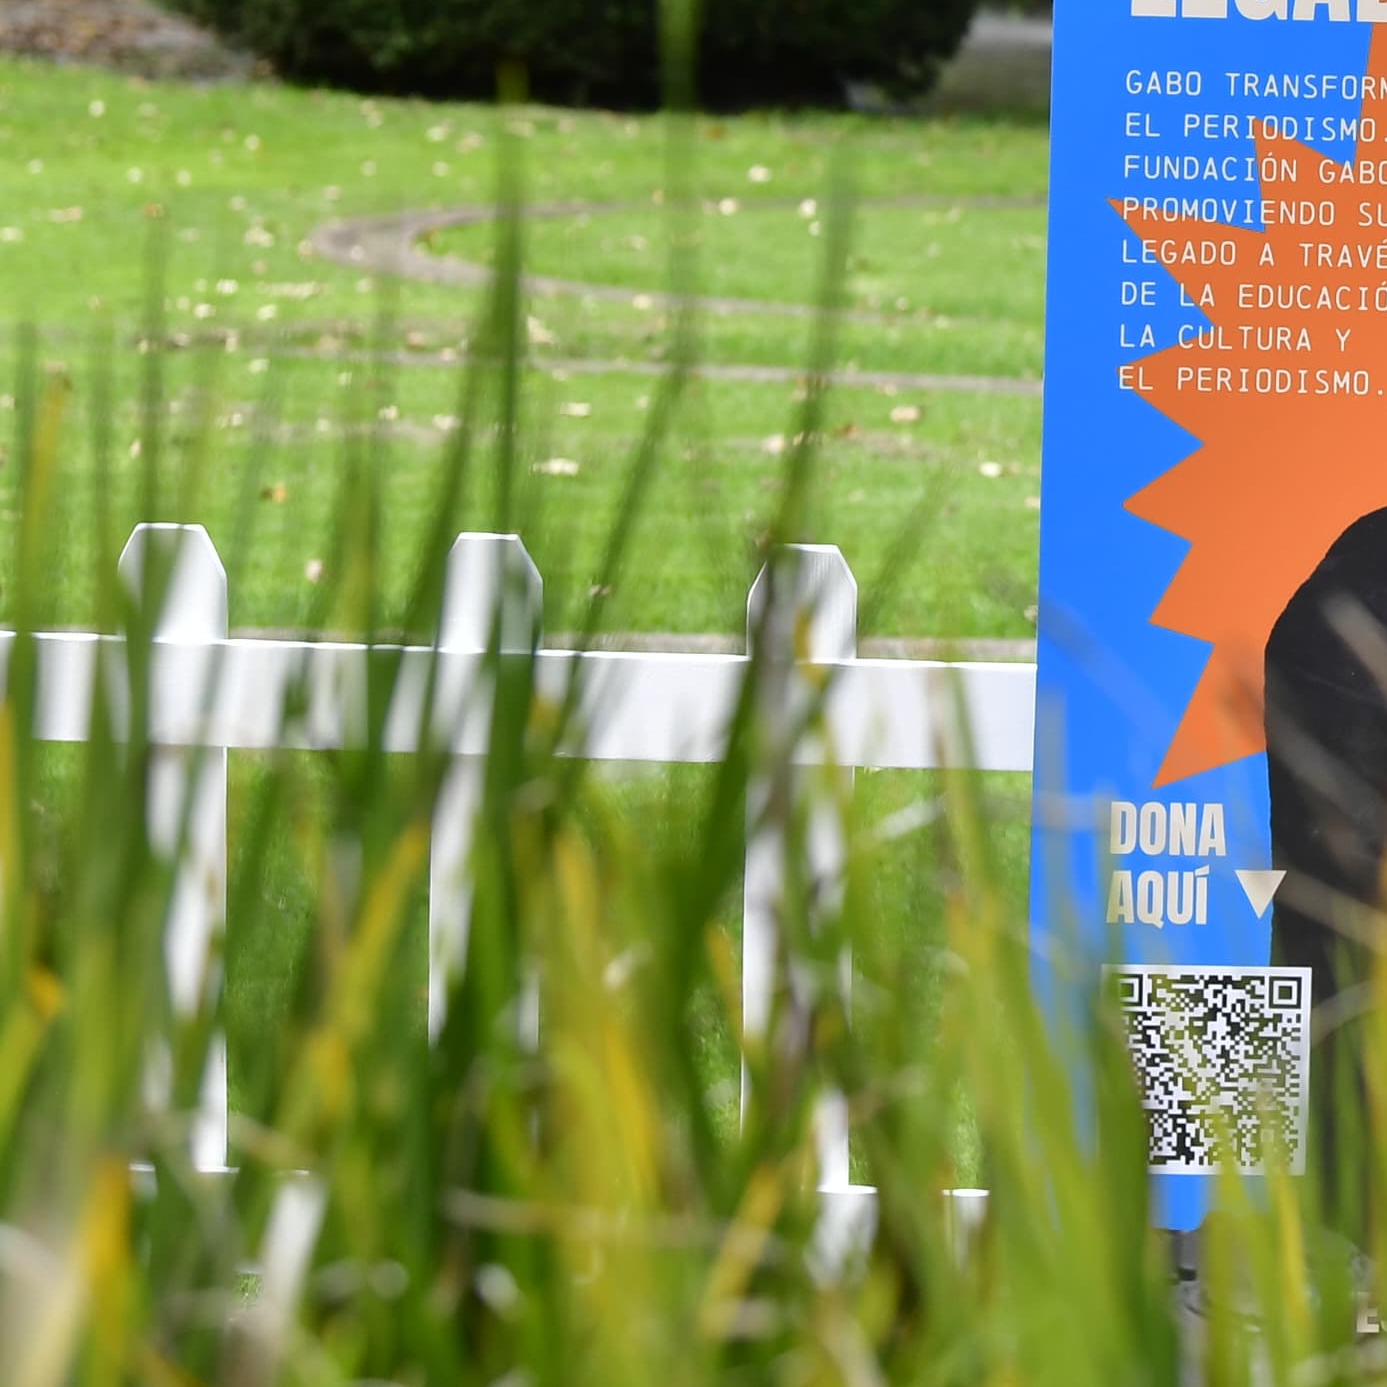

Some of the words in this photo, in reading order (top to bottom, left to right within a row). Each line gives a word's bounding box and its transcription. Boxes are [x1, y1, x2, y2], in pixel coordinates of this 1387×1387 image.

[1126, 69, 1201, 96] GABO
[1126, 112, 1160, 137] EL
[1124, 152, 1297, 182] FUNDACIÓN
[1122, 197, 1335, 226] PROMOVIENDO
[1122, 239, 1236, 266] LEGADO
[1259, 242, 1274, 266] A
[1121, 281, 1156, 306] DE
[1180, 283, 1215, 307] LA
[1120, 324, 1155, 348] LA
[1178, 324, 1311, 351] CULTURA
[1335, 328, 1351, 352] Y
[1119, 365, 1153, 390] EL
[1177, 366, 1383, 395] PERIODISMO.
[1109, 800, 1227, 857] DONA
[1106, 864, 1210, 929] AQUÍ
